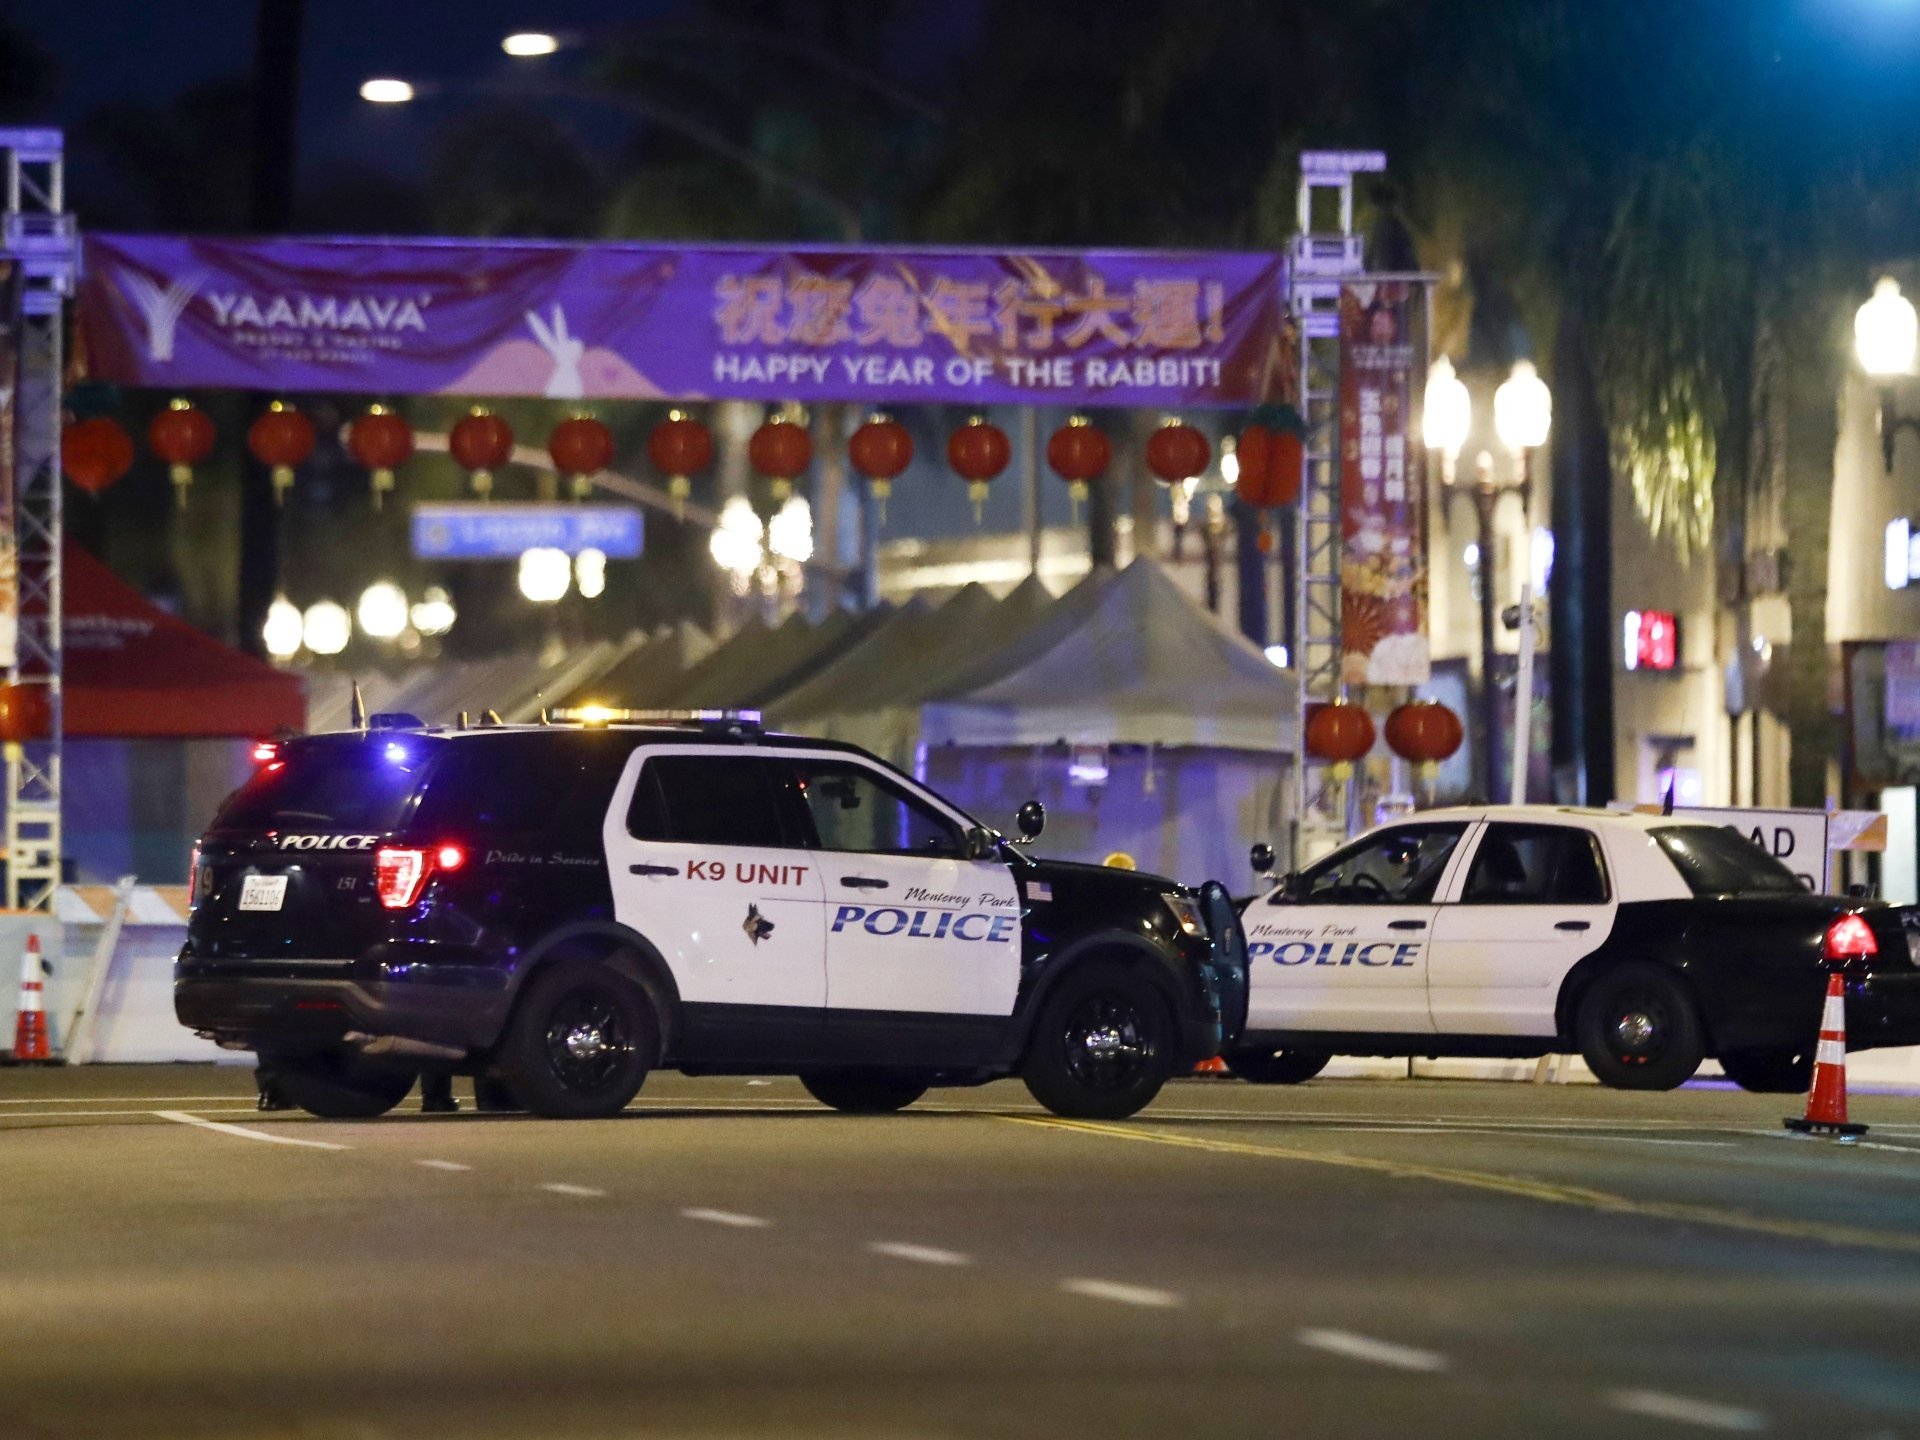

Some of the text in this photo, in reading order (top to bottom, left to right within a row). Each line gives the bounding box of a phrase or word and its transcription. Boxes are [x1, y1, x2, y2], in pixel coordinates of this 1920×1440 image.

[713, 355, 1221, 387] HAPPY YEAR OF THE RABBIT!
[280, 834, 380, 850] POLICE
[1750, 826, 1795, 858] AD
[485, 850, 600, 866] Pride in Service
[687, 860, 808, 886] K9 UNIT
[904, 887, 1015, 908] Monterey Park
[830, 906, 1017, 943] POLICE
[1250, 924, 1357, 939] Monterey Park
[1249, 942, 1422, 967] POLICE
